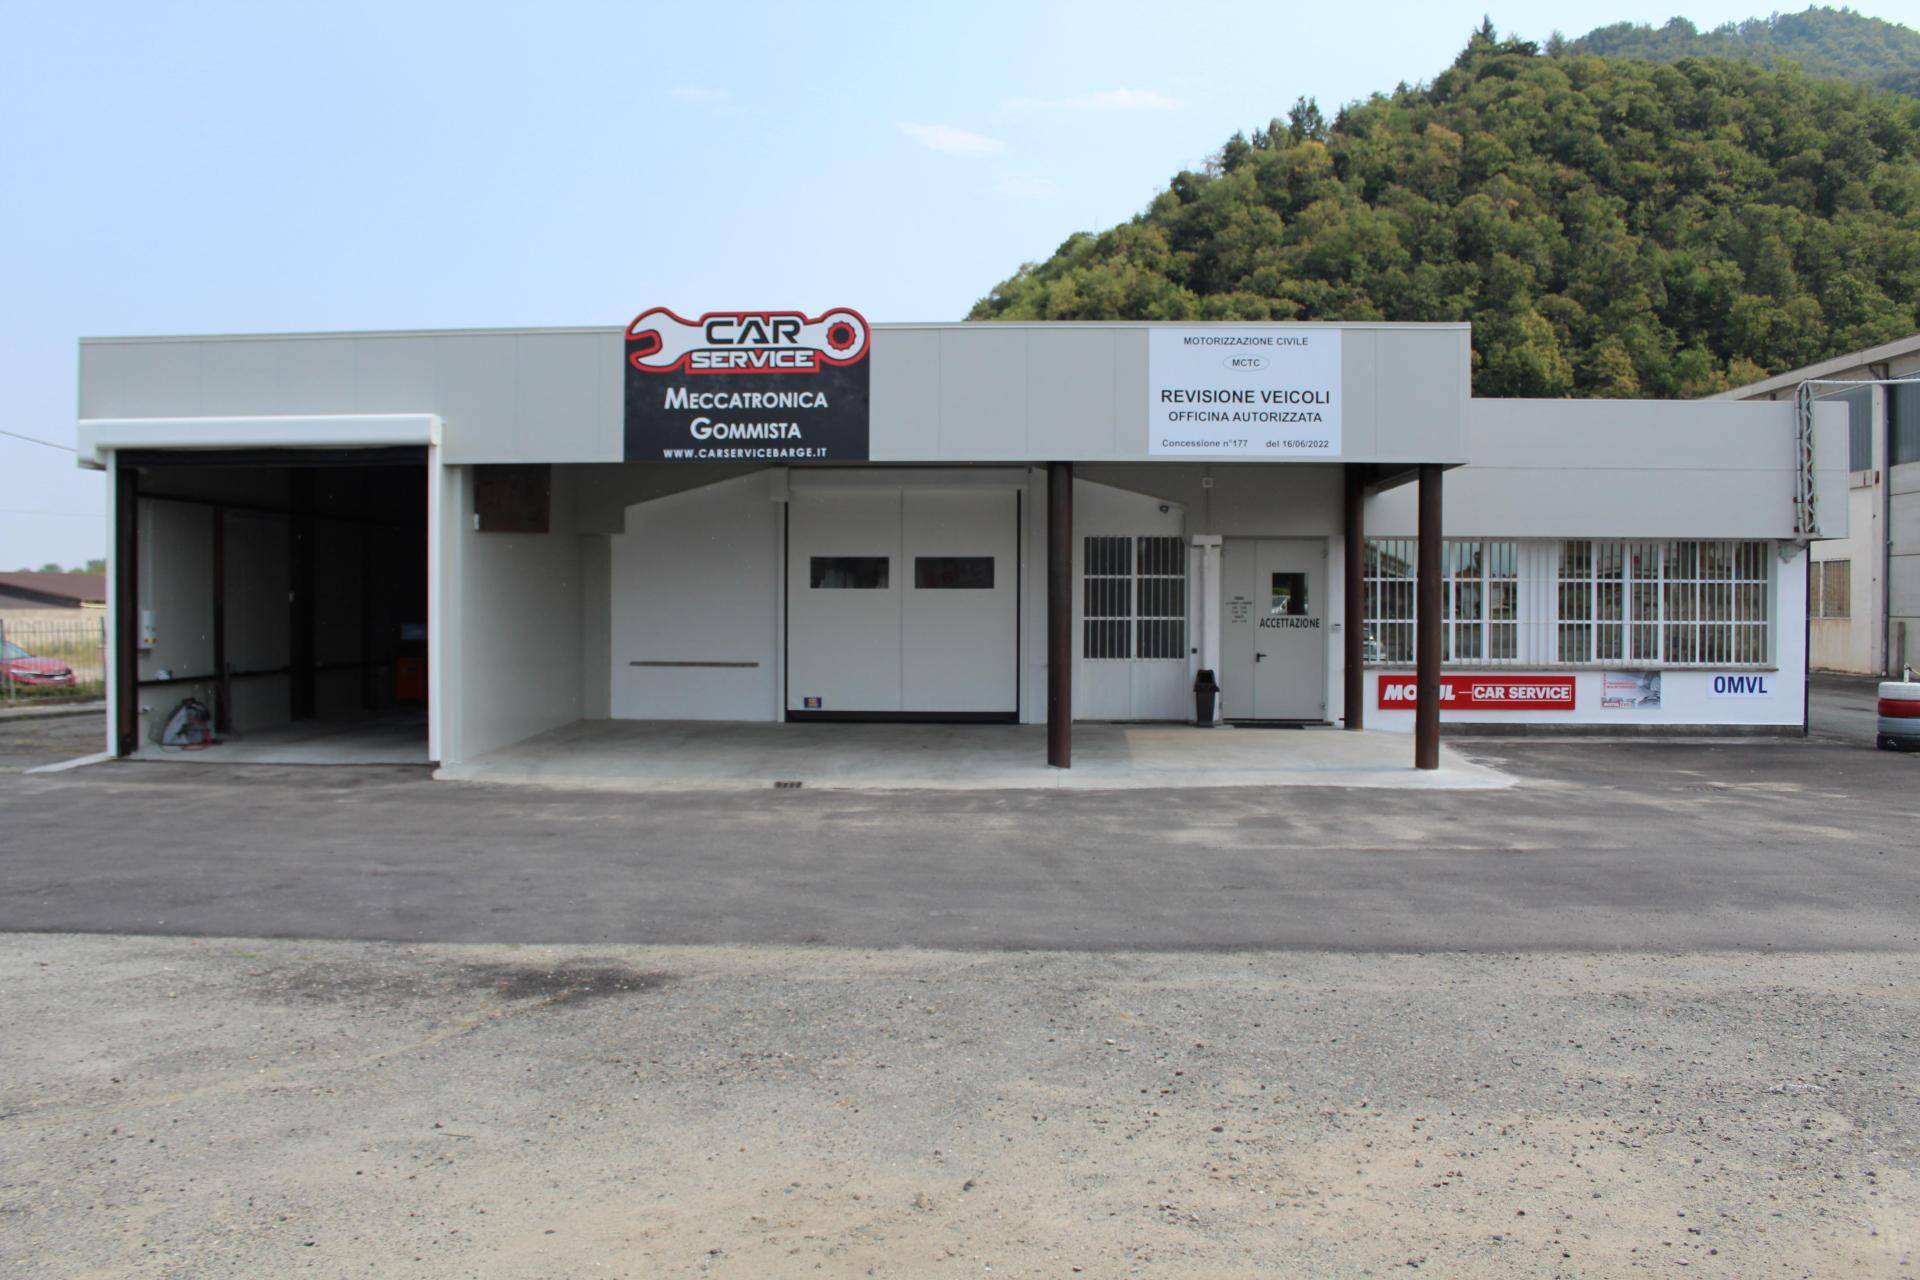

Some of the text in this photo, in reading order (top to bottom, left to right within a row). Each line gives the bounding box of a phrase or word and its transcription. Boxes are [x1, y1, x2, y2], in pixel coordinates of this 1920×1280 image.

[706, 320, 800, 345] CAR
[1184, 337, 1309, 346] MOTORIZZAZIONE CIVILE
[691, 351, 814, 368] SERVICE
[1232, 359, 1261, 367] MCTC
[1161, 389, 1330, 404] REVISIONE VEICOLI
[1168, 411, 1322, 423] OFFICINA AUTORIZZATA
[1162, 439, 1220, 448] Concessione
[1265, 439, 1280, 448] del
[1282, 439, 1329, 449] 16/06/2022
[663, 447, 827, 459] WWW.CARSERVICEBARGE.IT
[1259, 617, 1320, 629] ACCETTAZIONE
[1713, 676, 1768, 694] OMVL
[1474, 686, 1506, 699] CAR
[1508, 686, 1570, 699] SERVICE
